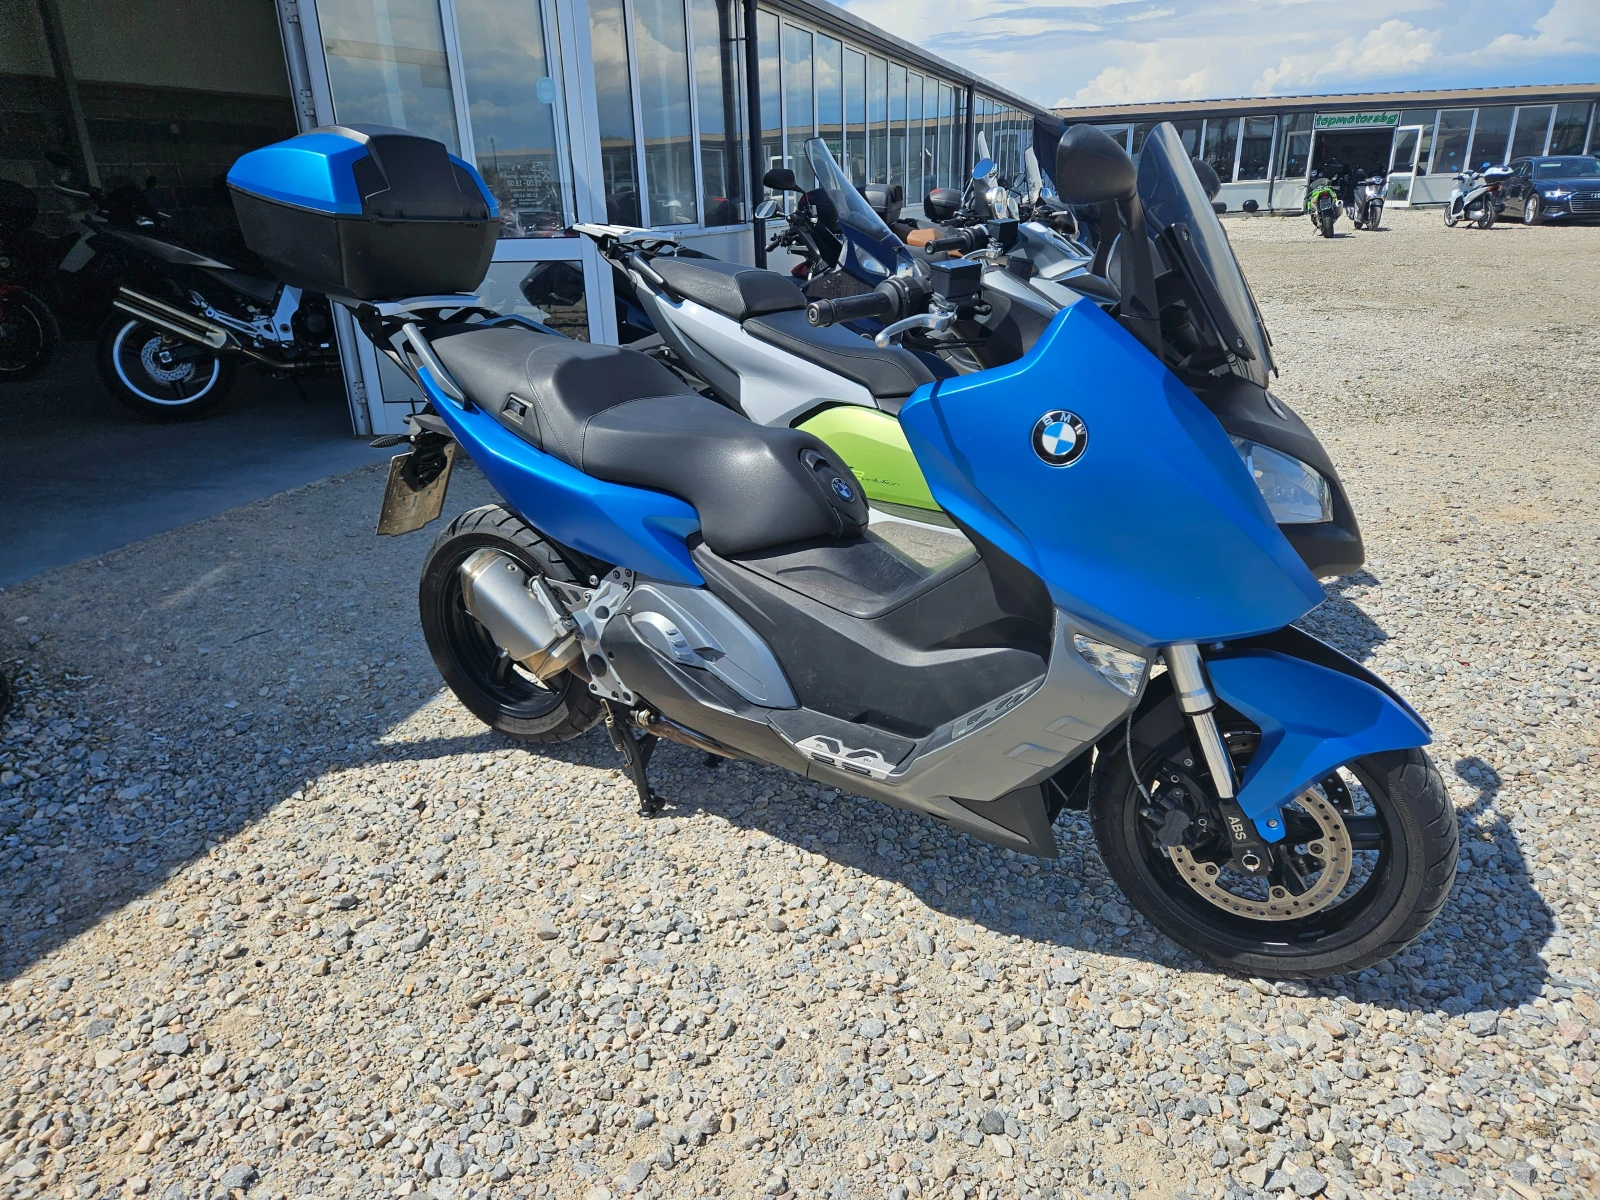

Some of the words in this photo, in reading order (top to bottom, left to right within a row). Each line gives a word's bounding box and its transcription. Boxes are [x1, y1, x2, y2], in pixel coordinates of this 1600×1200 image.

[1316, 112, 1398, 127] topmotorsbg
[1042, 412, 1086, 436] BMW
[1228, 816, 1247, 840] ABS
